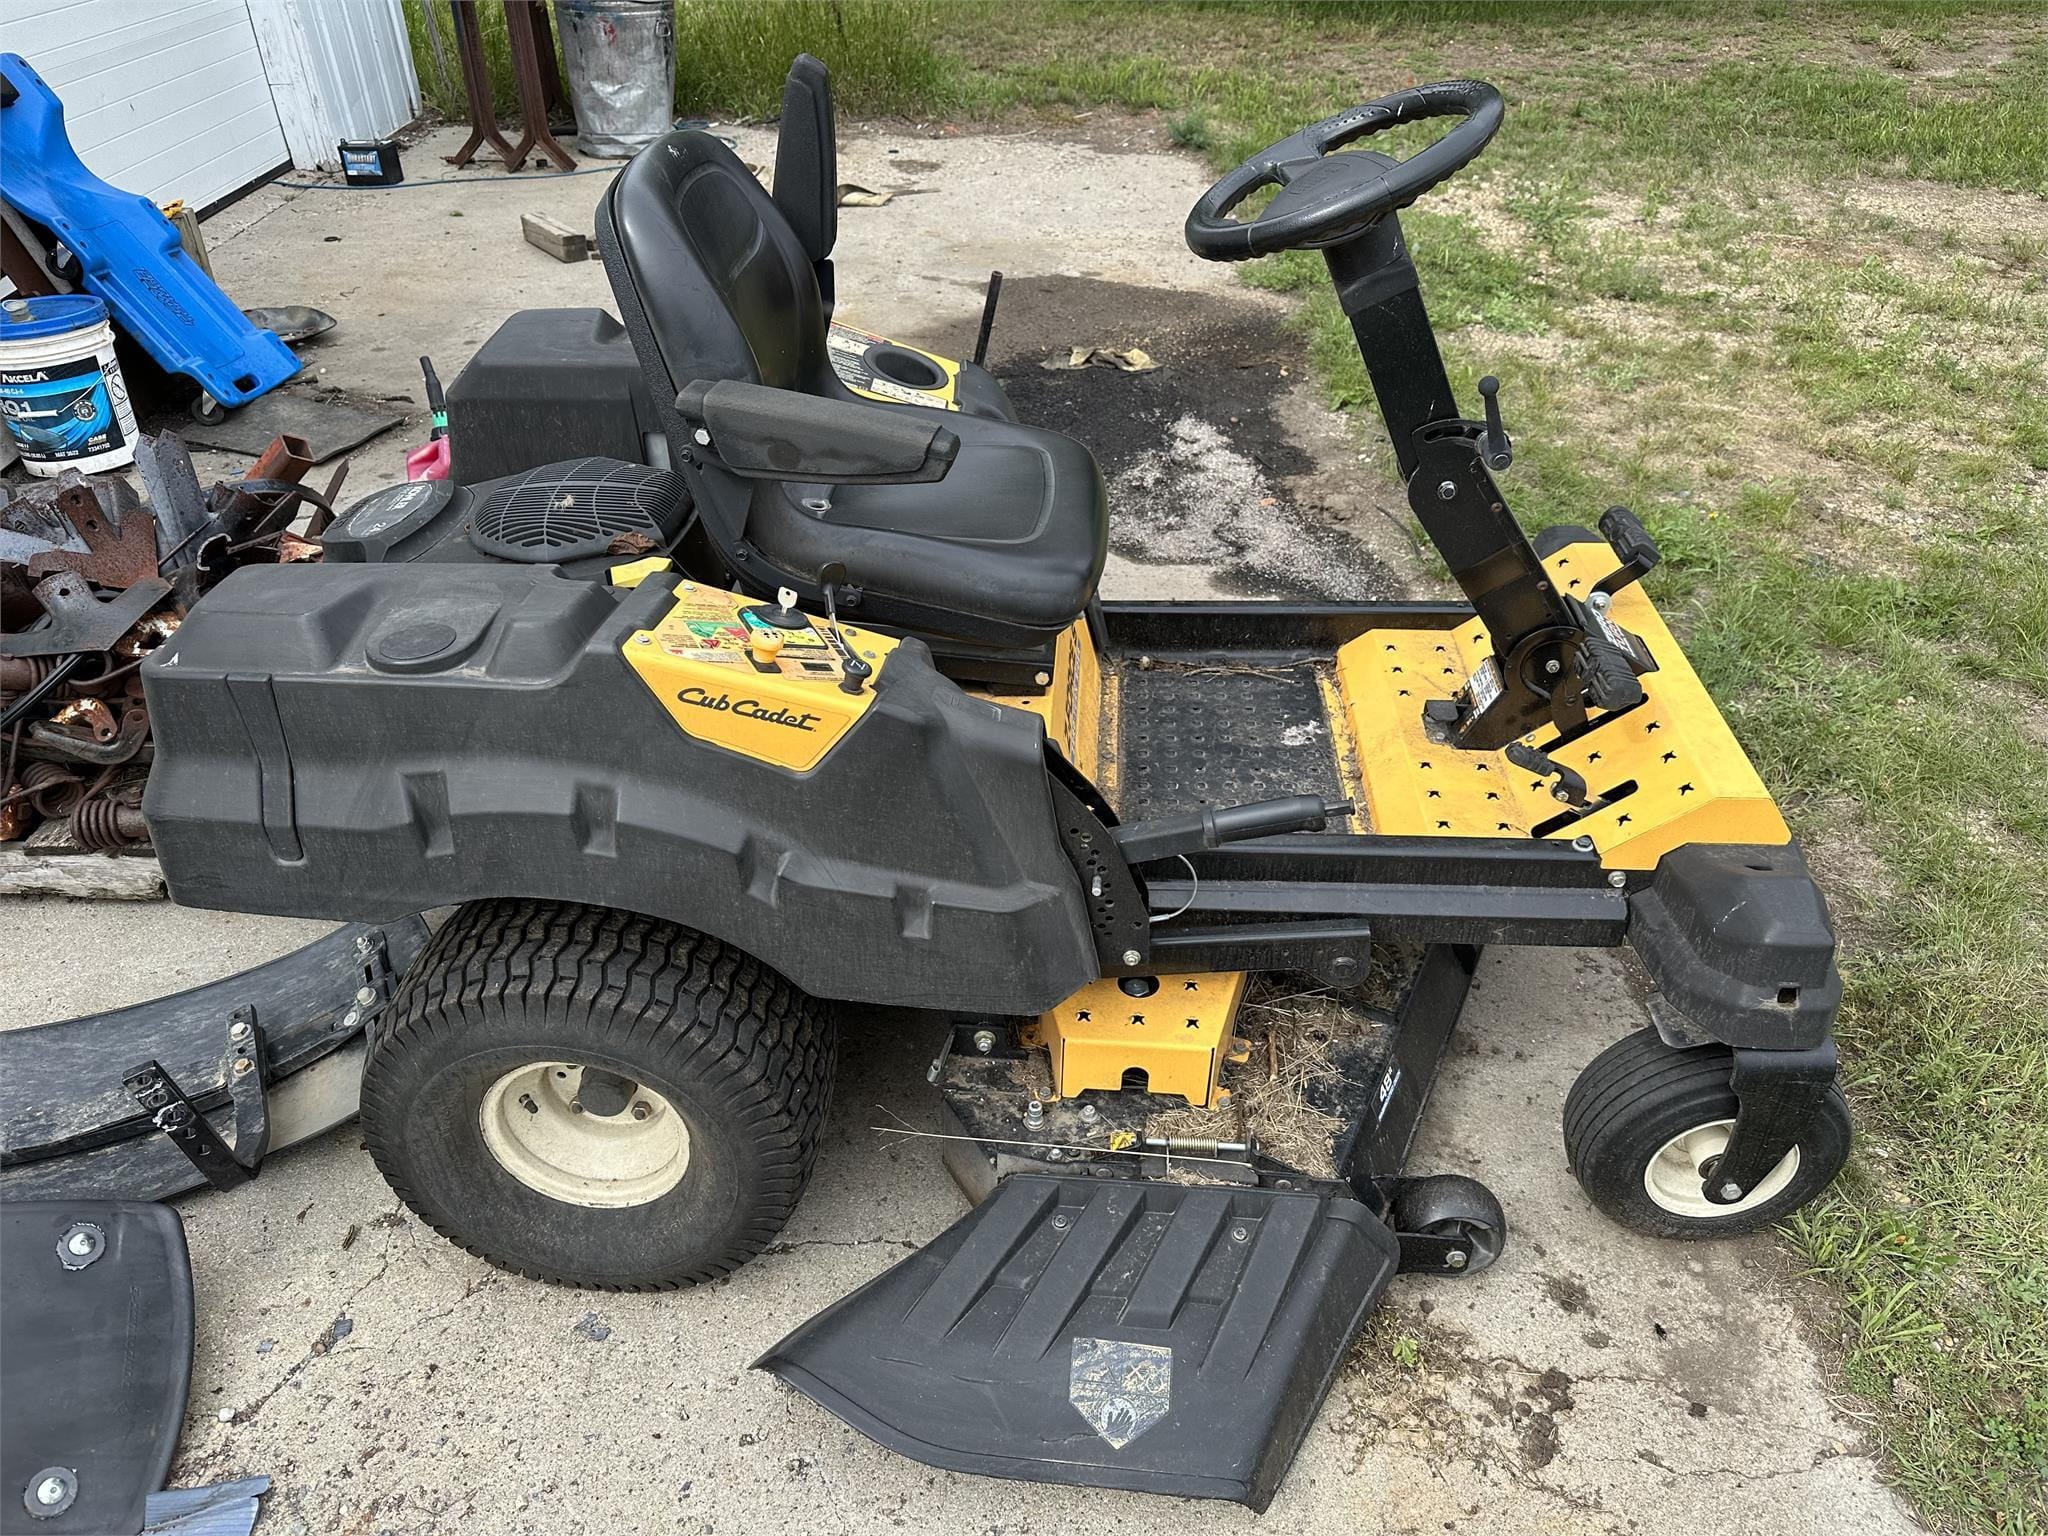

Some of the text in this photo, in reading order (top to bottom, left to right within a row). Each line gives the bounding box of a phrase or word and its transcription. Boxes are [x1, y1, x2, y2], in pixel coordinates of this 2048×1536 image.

[2, 371, 49, 383] AKCELA
[391, 485, 426, 511] KOHLER
[677, 687, 822, 731] Cub Cadet
